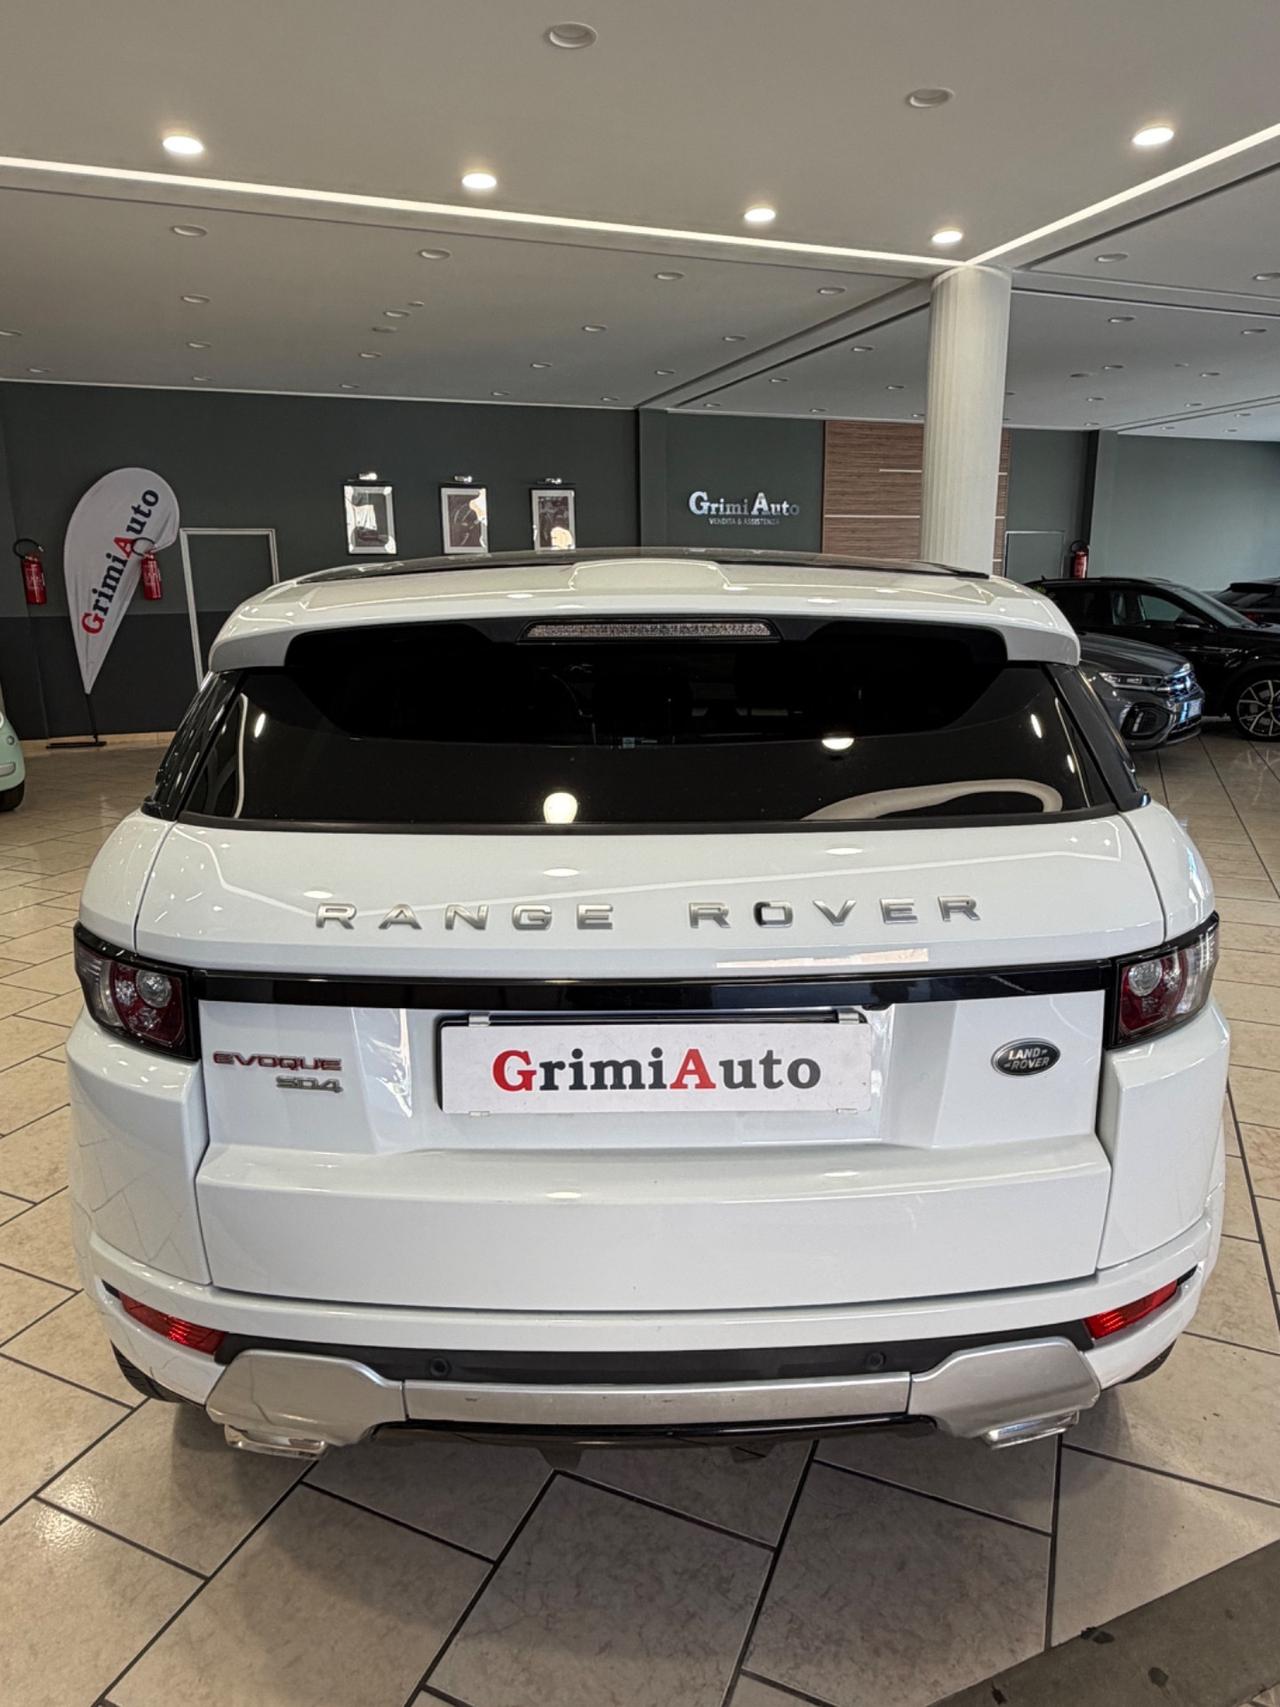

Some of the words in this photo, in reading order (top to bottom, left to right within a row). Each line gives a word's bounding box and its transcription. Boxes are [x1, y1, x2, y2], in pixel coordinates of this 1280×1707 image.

[81, 489, 159, 634] GrimiAuto
[316, 902, 614, 930] RANGE
[688, 895, 980, 929] ROVER
[213, 1051, 342, 1071] EVOQUE
[1008, 1047, 1041, 1060] LAND
[1011, 1057, 1049, 1070] ROVER
[492, 1047, 821, 1091] GrimiAuto
[276, 1075, 343, 1093] SD4
